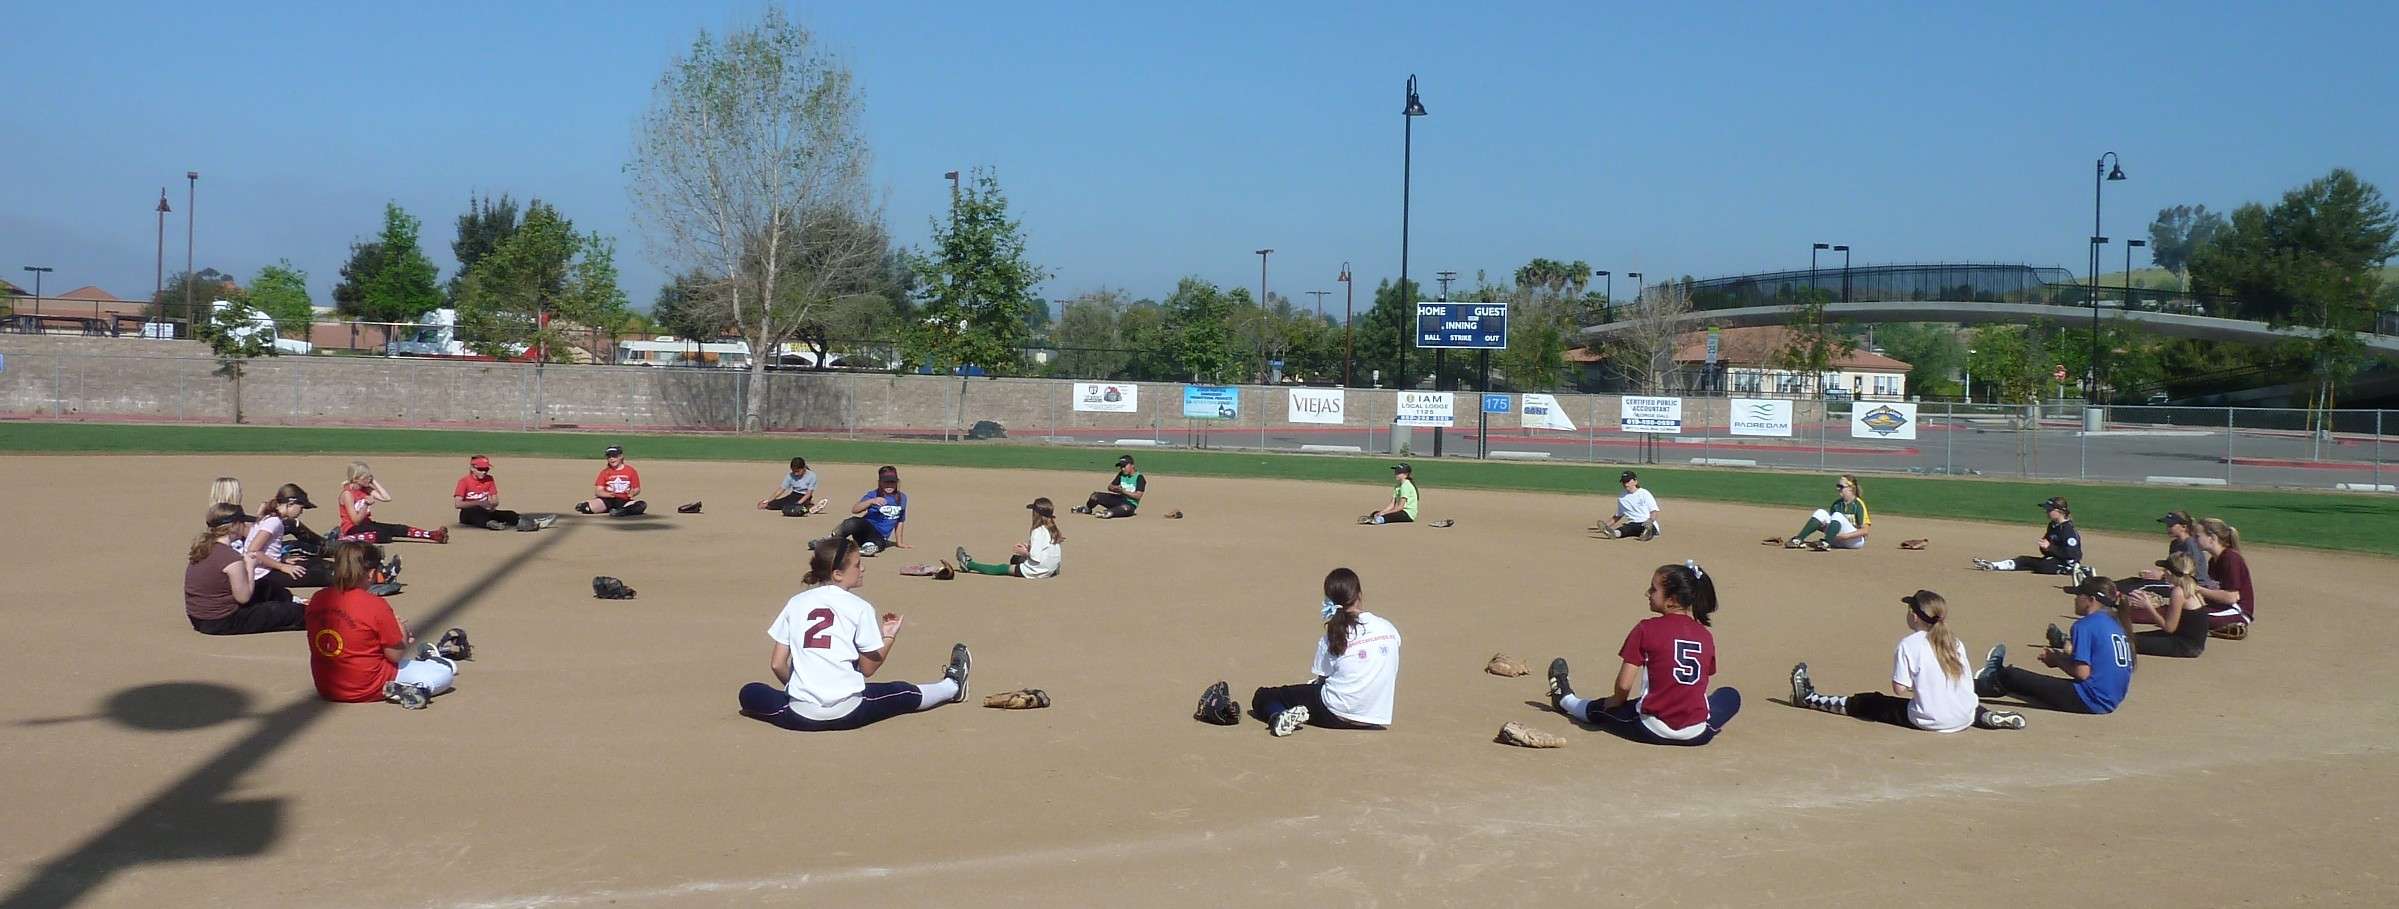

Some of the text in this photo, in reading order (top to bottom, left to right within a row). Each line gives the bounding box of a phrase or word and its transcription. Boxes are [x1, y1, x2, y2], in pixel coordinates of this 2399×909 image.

[1417, 306, 1506, 317] HOME GUEST
[1446, 321, 1477, 330] INNING
[1450, 334, 1472, 342] STRIKE
[1293, 393, 1340, 417] VIEJAS
[1486, 398, 1507, 410] 175
[803, 608, 834, 649] 2
[1673, 639, 1702, 685] 5
